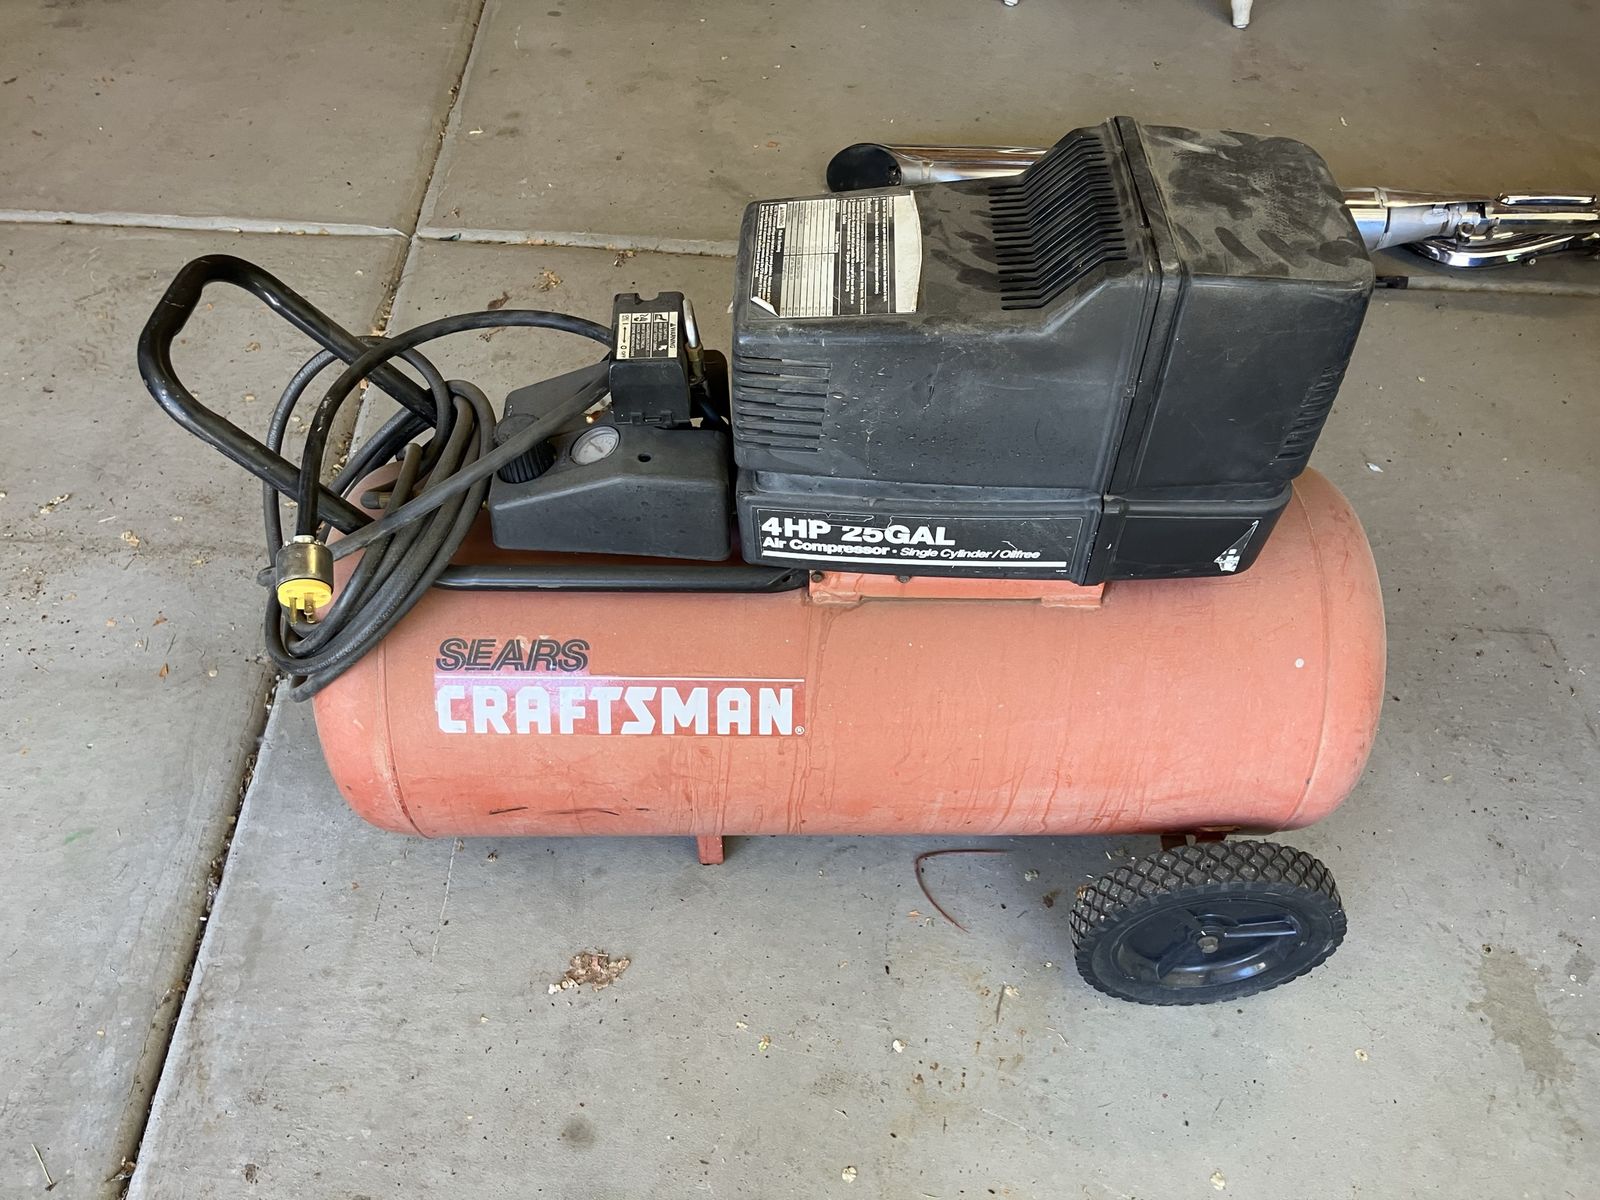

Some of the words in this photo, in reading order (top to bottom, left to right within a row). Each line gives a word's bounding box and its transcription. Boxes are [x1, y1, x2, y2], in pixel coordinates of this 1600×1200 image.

[762, 536, 787, 548] Air
[789, 539, 891, 555] Compressor
[900, 547, 939, 559] Single
[1000, 550, 1041, 559] Oilfree
[841, 525, 955, 546] 25GAL
[436, 637, 590, 671] SEARS
[436, 685, 793, 735] CRAFTSMAN
